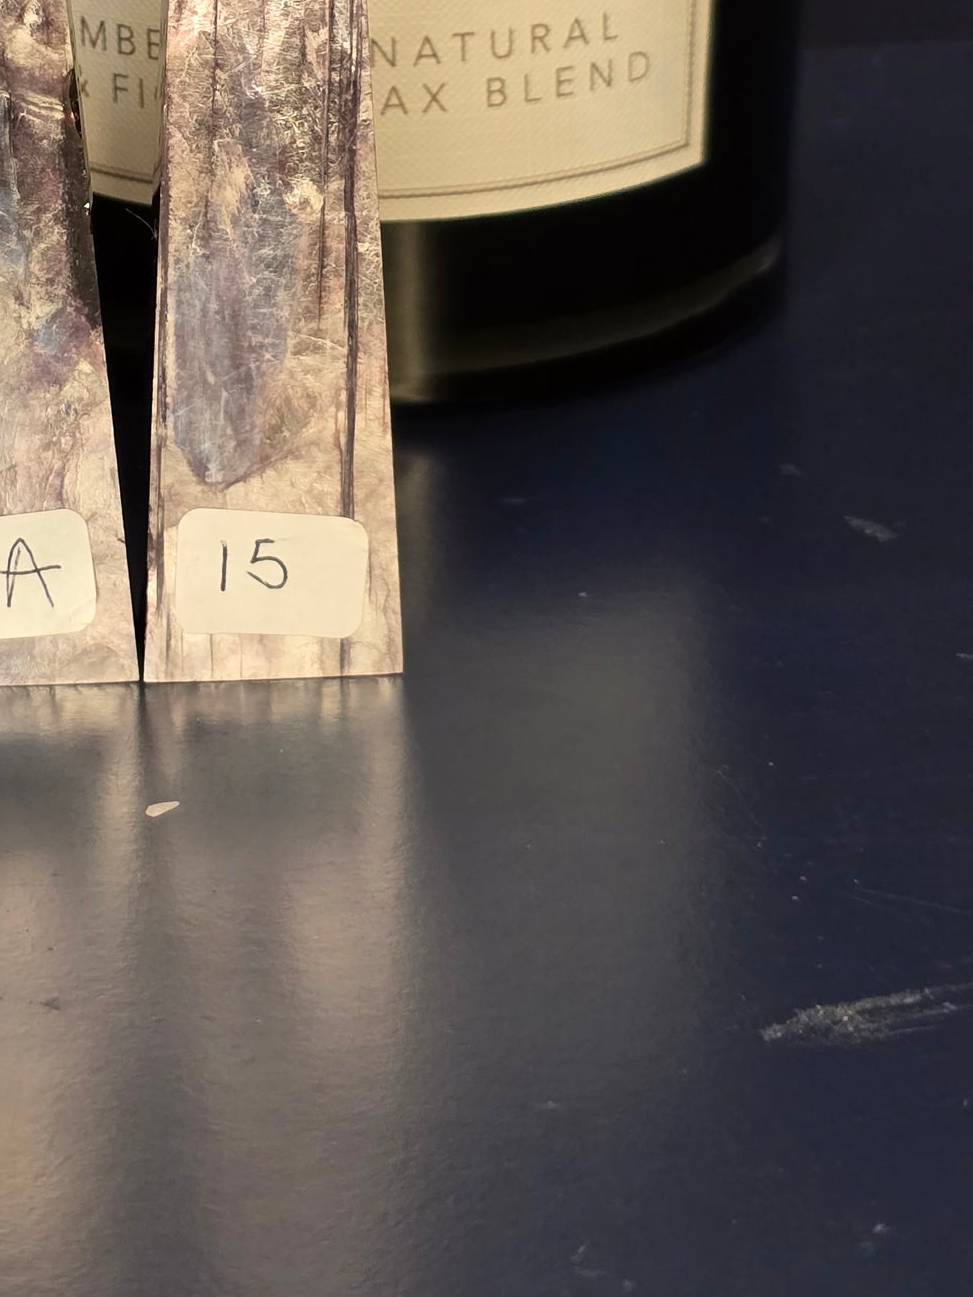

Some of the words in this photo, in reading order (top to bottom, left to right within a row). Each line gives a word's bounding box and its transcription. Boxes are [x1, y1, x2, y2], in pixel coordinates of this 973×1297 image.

[79, 15, 161, 61] MBE
[371, 11, 619, 69] NATURAL
[112, 72, 159, 109] FI
[380, 82, 447, 116] AX
[486, 50, 651, 108] BLEND
[220, 538, 288, 592] 15
